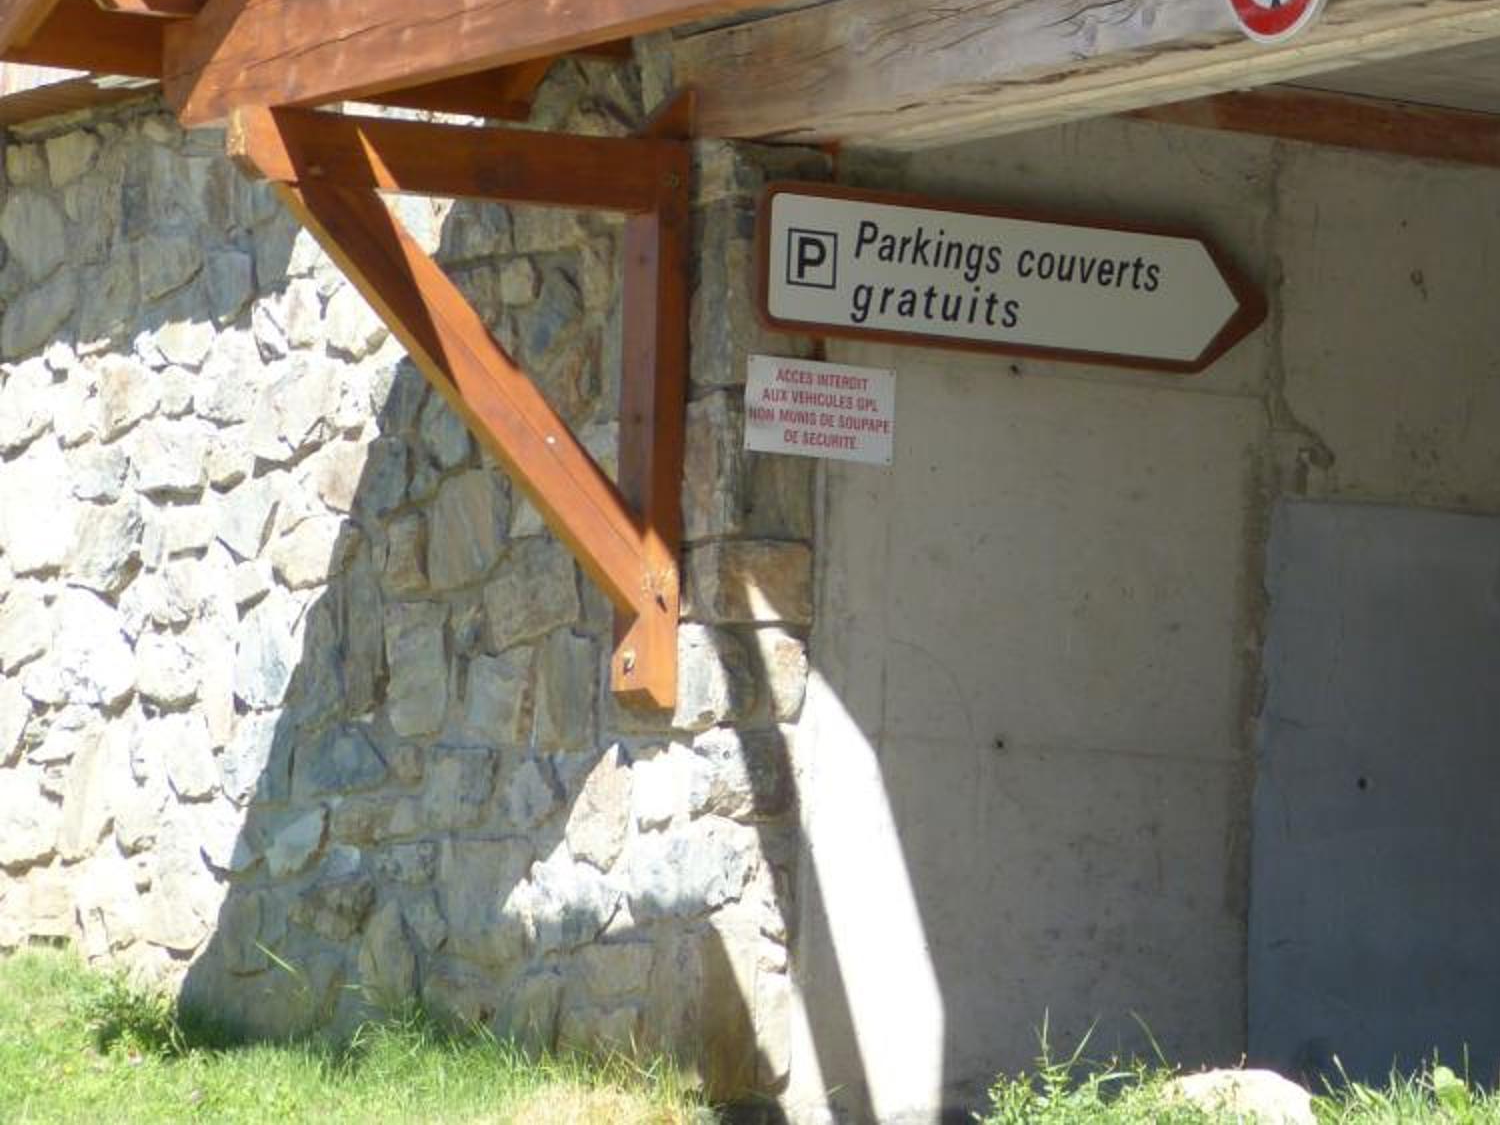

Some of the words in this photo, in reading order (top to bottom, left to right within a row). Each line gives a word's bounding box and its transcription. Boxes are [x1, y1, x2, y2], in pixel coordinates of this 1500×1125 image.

[798, 236, 827, 279] P
[854, 220, 1001, 283] Parkings
[1017, 248, 1161, 292] couverts
[850, 282, 1020, 328] gratuits
[776, 368, 813, 385] ACCES
[817, 374, 868, 391] INTERDIT
[762, 388, 788, 403] AUX
[792, 390, 853, 410] VEHICULES
[856, 397, 879, 412] GPL
[748, 406, 775, 422] NON
[779, 409, 817, 425] MUNIS
[820, 413, 835, 427] DE
[838, 414, 890, 434] SOUPAPE
[784, 429, 799, 443] DE
